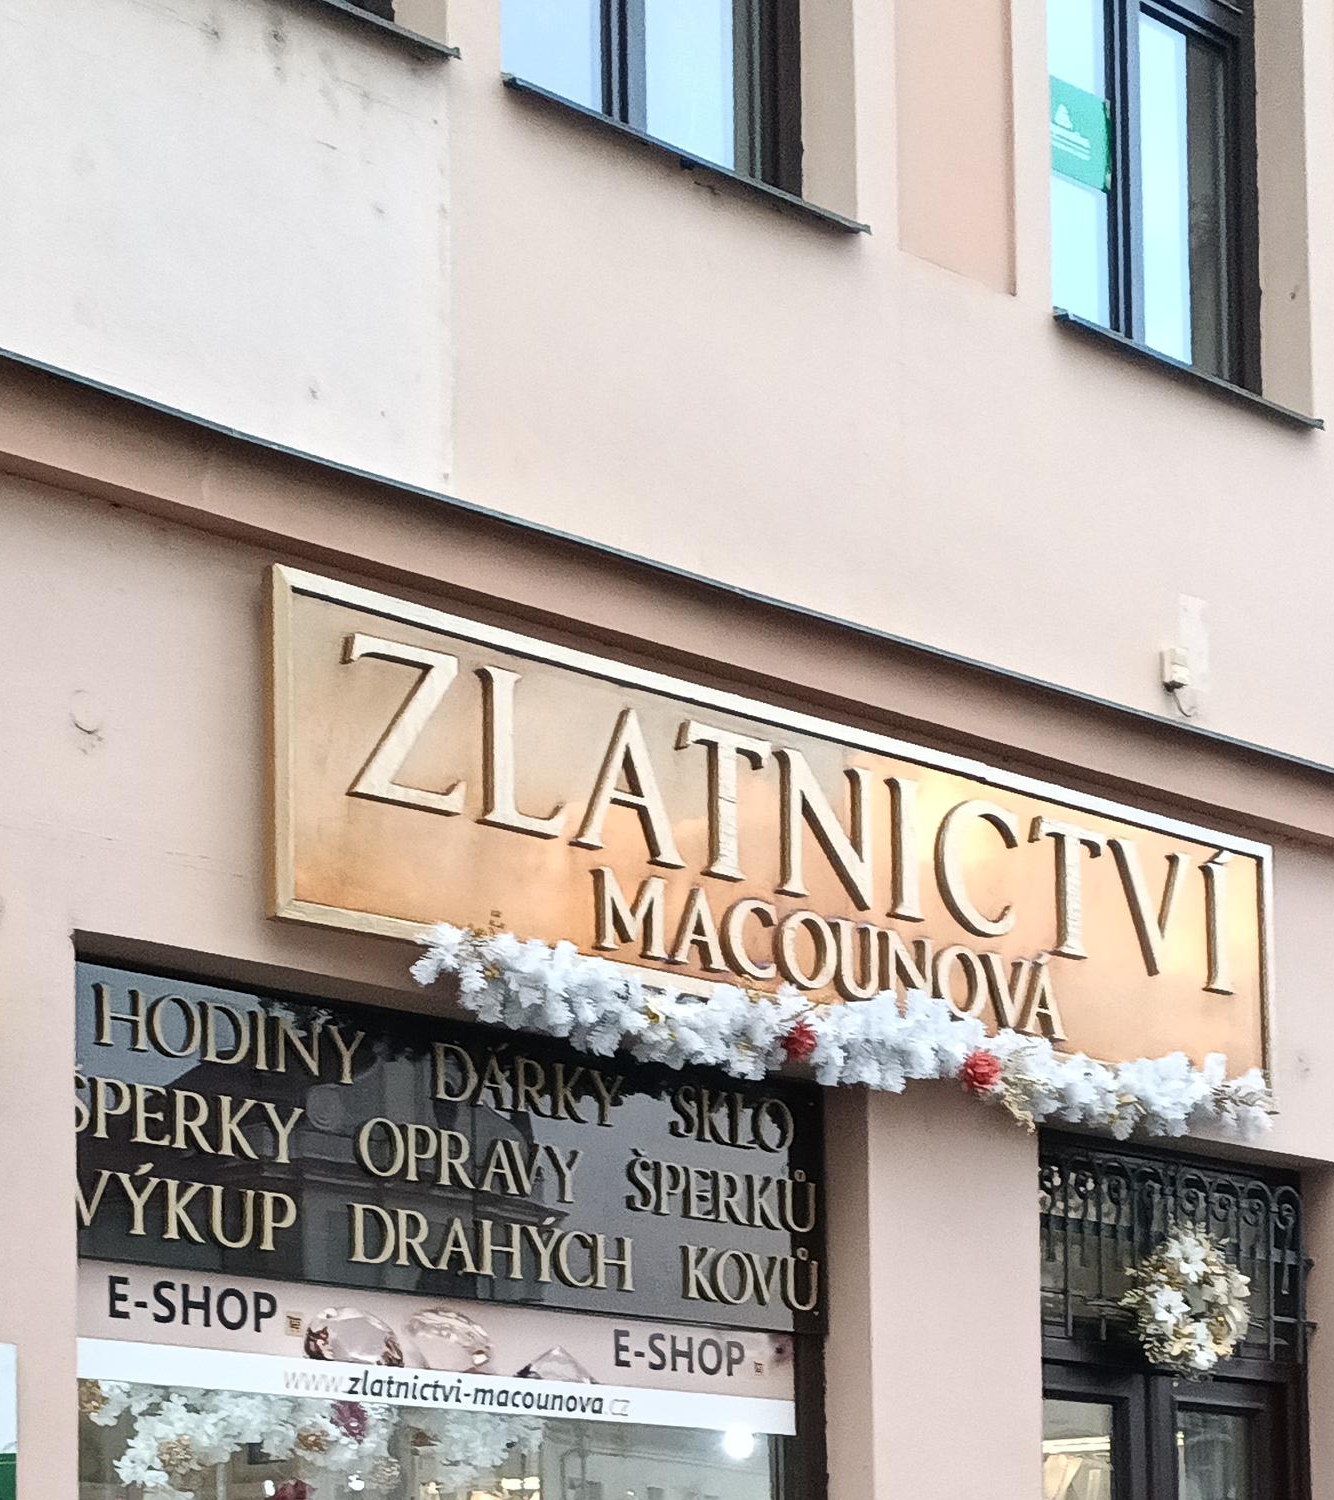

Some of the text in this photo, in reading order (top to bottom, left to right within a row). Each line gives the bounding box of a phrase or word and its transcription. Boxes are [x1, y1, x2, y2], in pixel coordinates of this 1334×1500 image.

[339, 632, 1235, 996] ZLATNICTVÍ
[588, 866, 1068, 1042] MACOUNOVÁ
[92, 981, 794, 1153] HODINY DÁRKY SKLO
[75, 1163, 819, 1312] VÝKUP DRAHÝCH KOVŮ
[355, 1117, 584, 1204] OPRAVY
[626, 1144, 816, 1233] ŠPERKŮ
[108, 1275, 278, 1333] E-SHOP
[613, 1328, 746, 1377] E-SHOP
